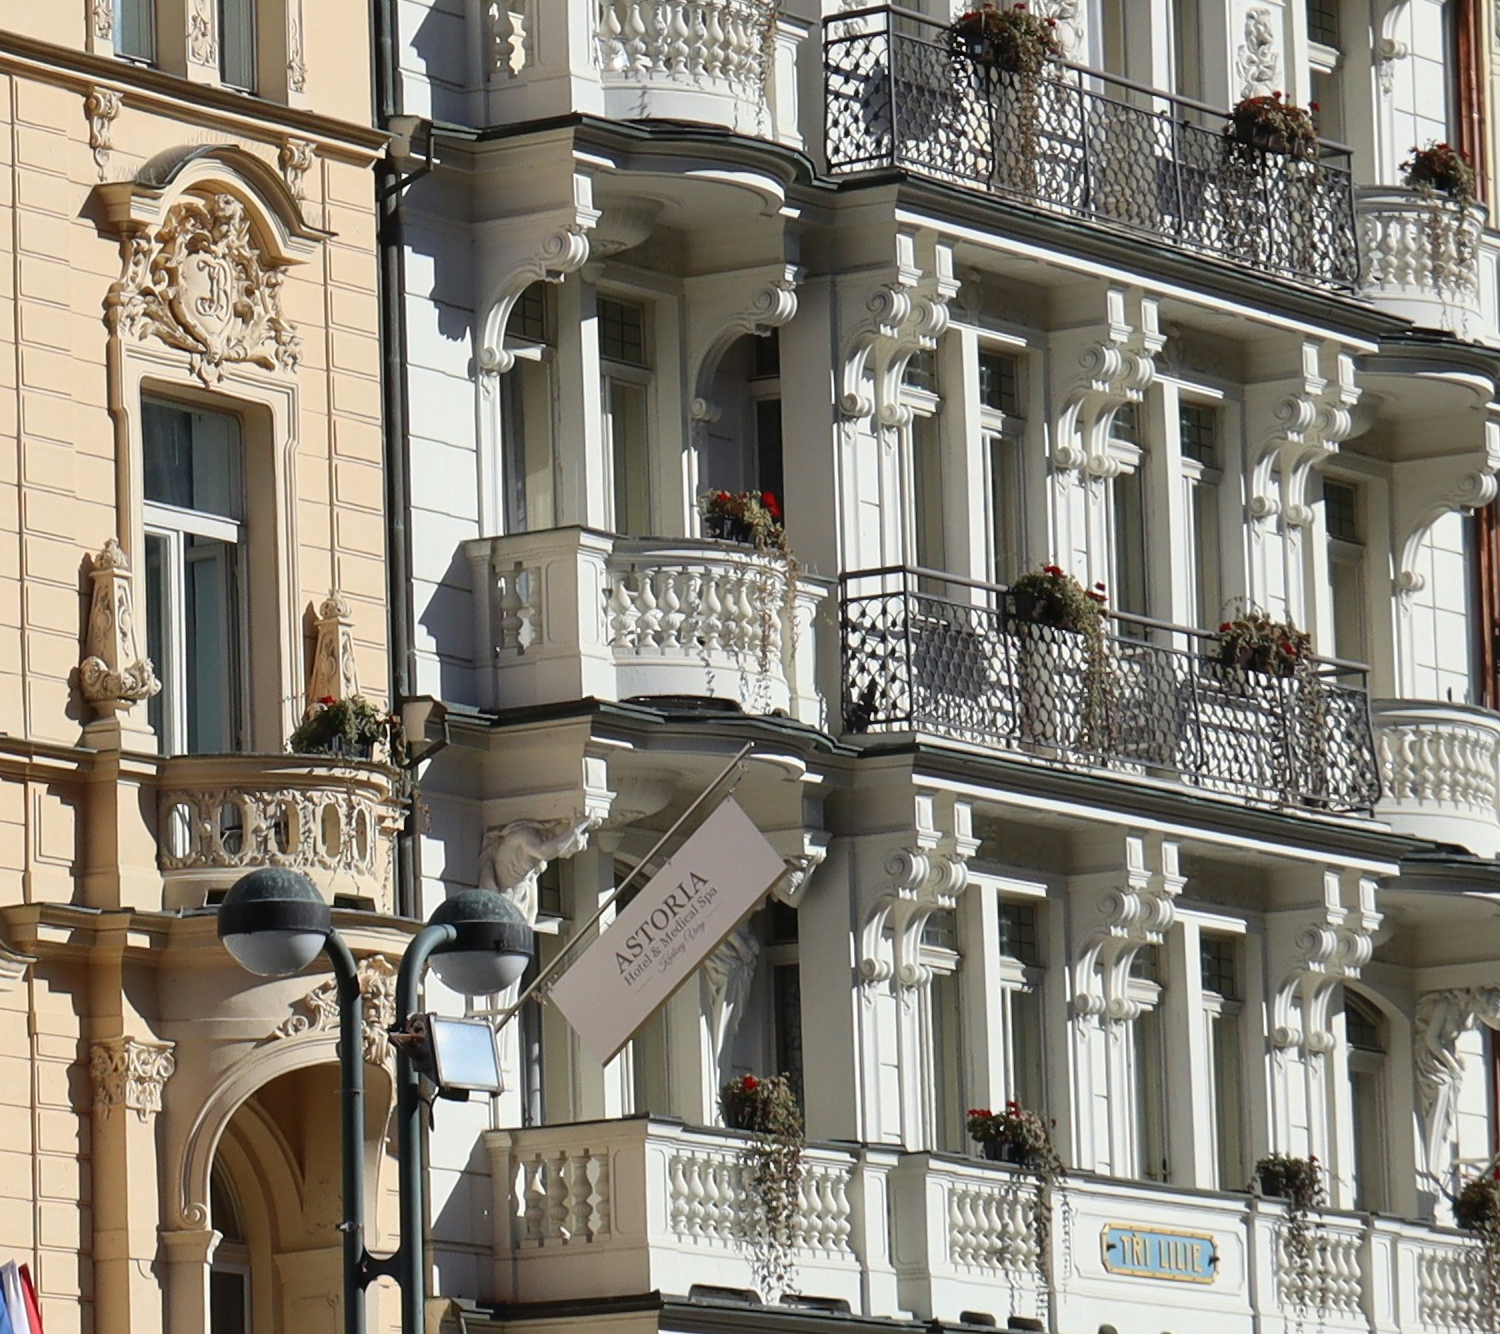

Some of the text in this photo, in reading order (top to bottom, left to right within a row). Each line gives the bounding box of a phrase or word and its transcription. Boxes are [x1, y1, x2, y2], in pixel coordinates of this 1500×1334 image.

[615, 871, 709, 976] ASTORIA
[623, 887, 718, 986] Hotel & Medical Spa
[1158, 1239, 1203, 1273] LILIE
